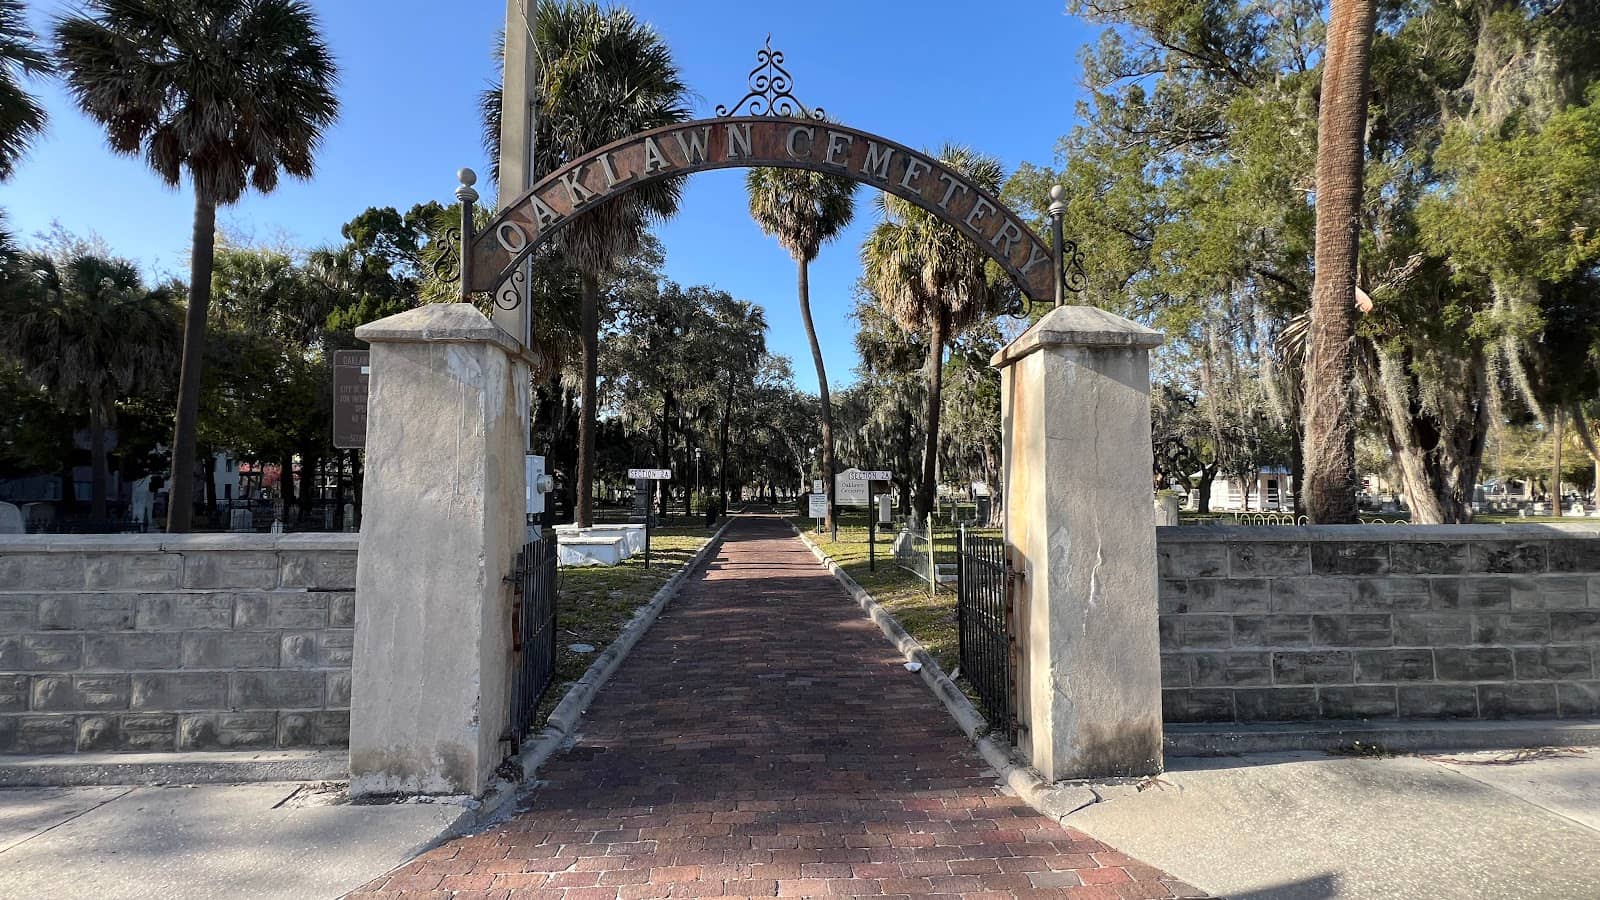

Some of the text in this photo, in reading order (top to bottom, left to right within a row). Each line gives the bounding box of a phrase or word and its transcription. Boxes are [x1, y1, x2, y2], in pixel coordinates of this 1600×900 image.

[497, 121, 1053, 276] OAKLAWN CEMETERY
[630, 470, 669, 478] SECTION 2A
[849, 471, 890, 480] SECTION 2A
